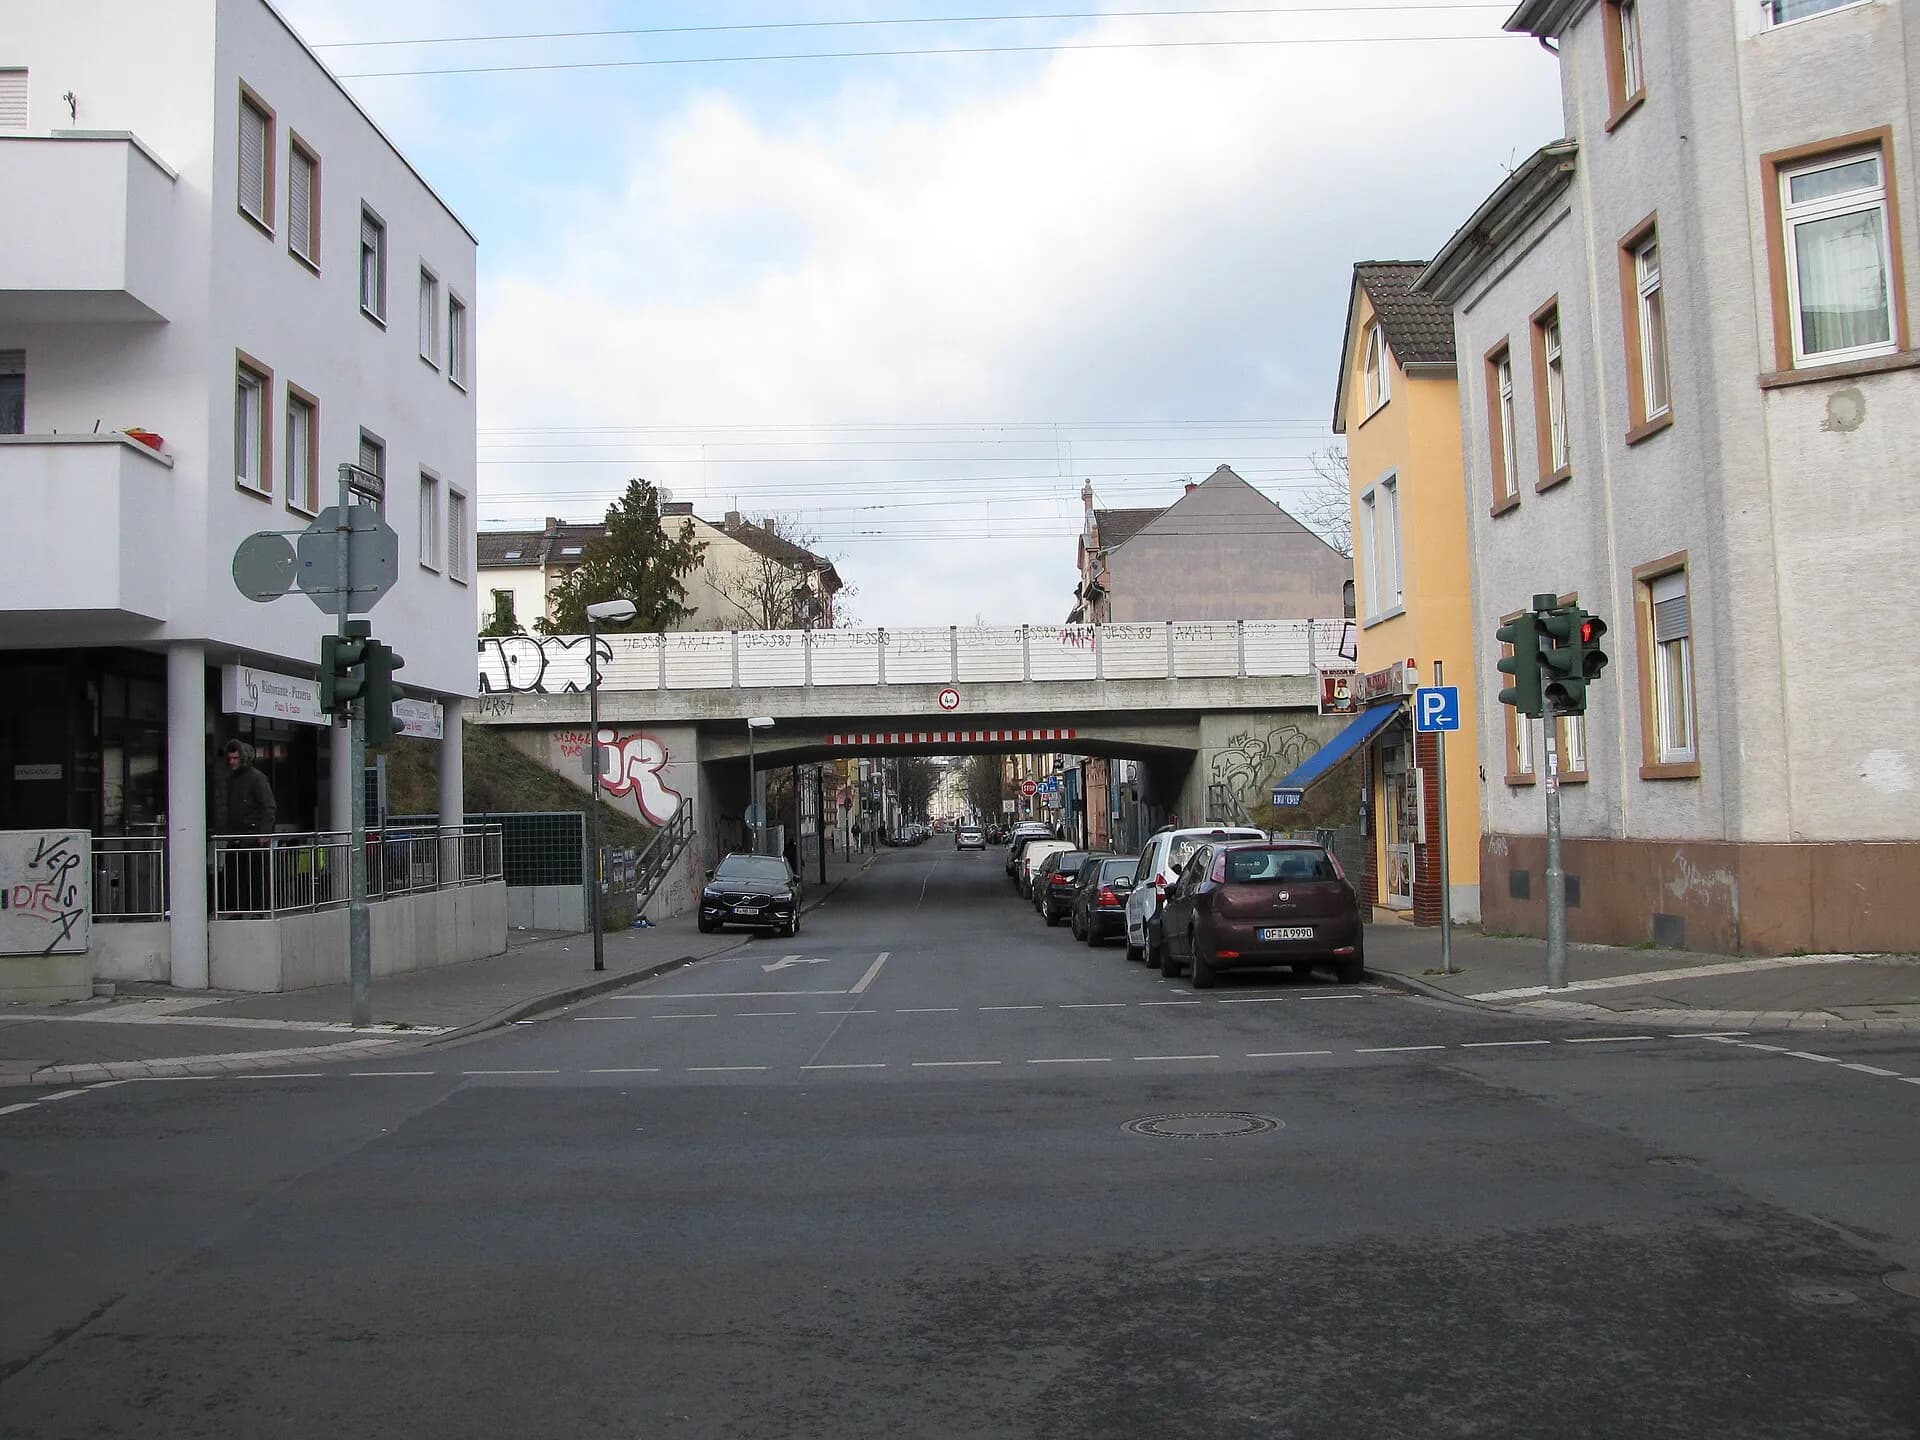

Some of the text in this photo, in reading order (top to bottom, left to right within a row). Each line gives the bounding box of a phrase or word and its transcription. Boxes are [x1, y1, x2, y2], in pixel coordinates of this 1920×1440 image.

[1423, 692, 1446, 726] P
[1023, 784, 1036, 792] STOP
[1265, 930, 1277, 939] OF
